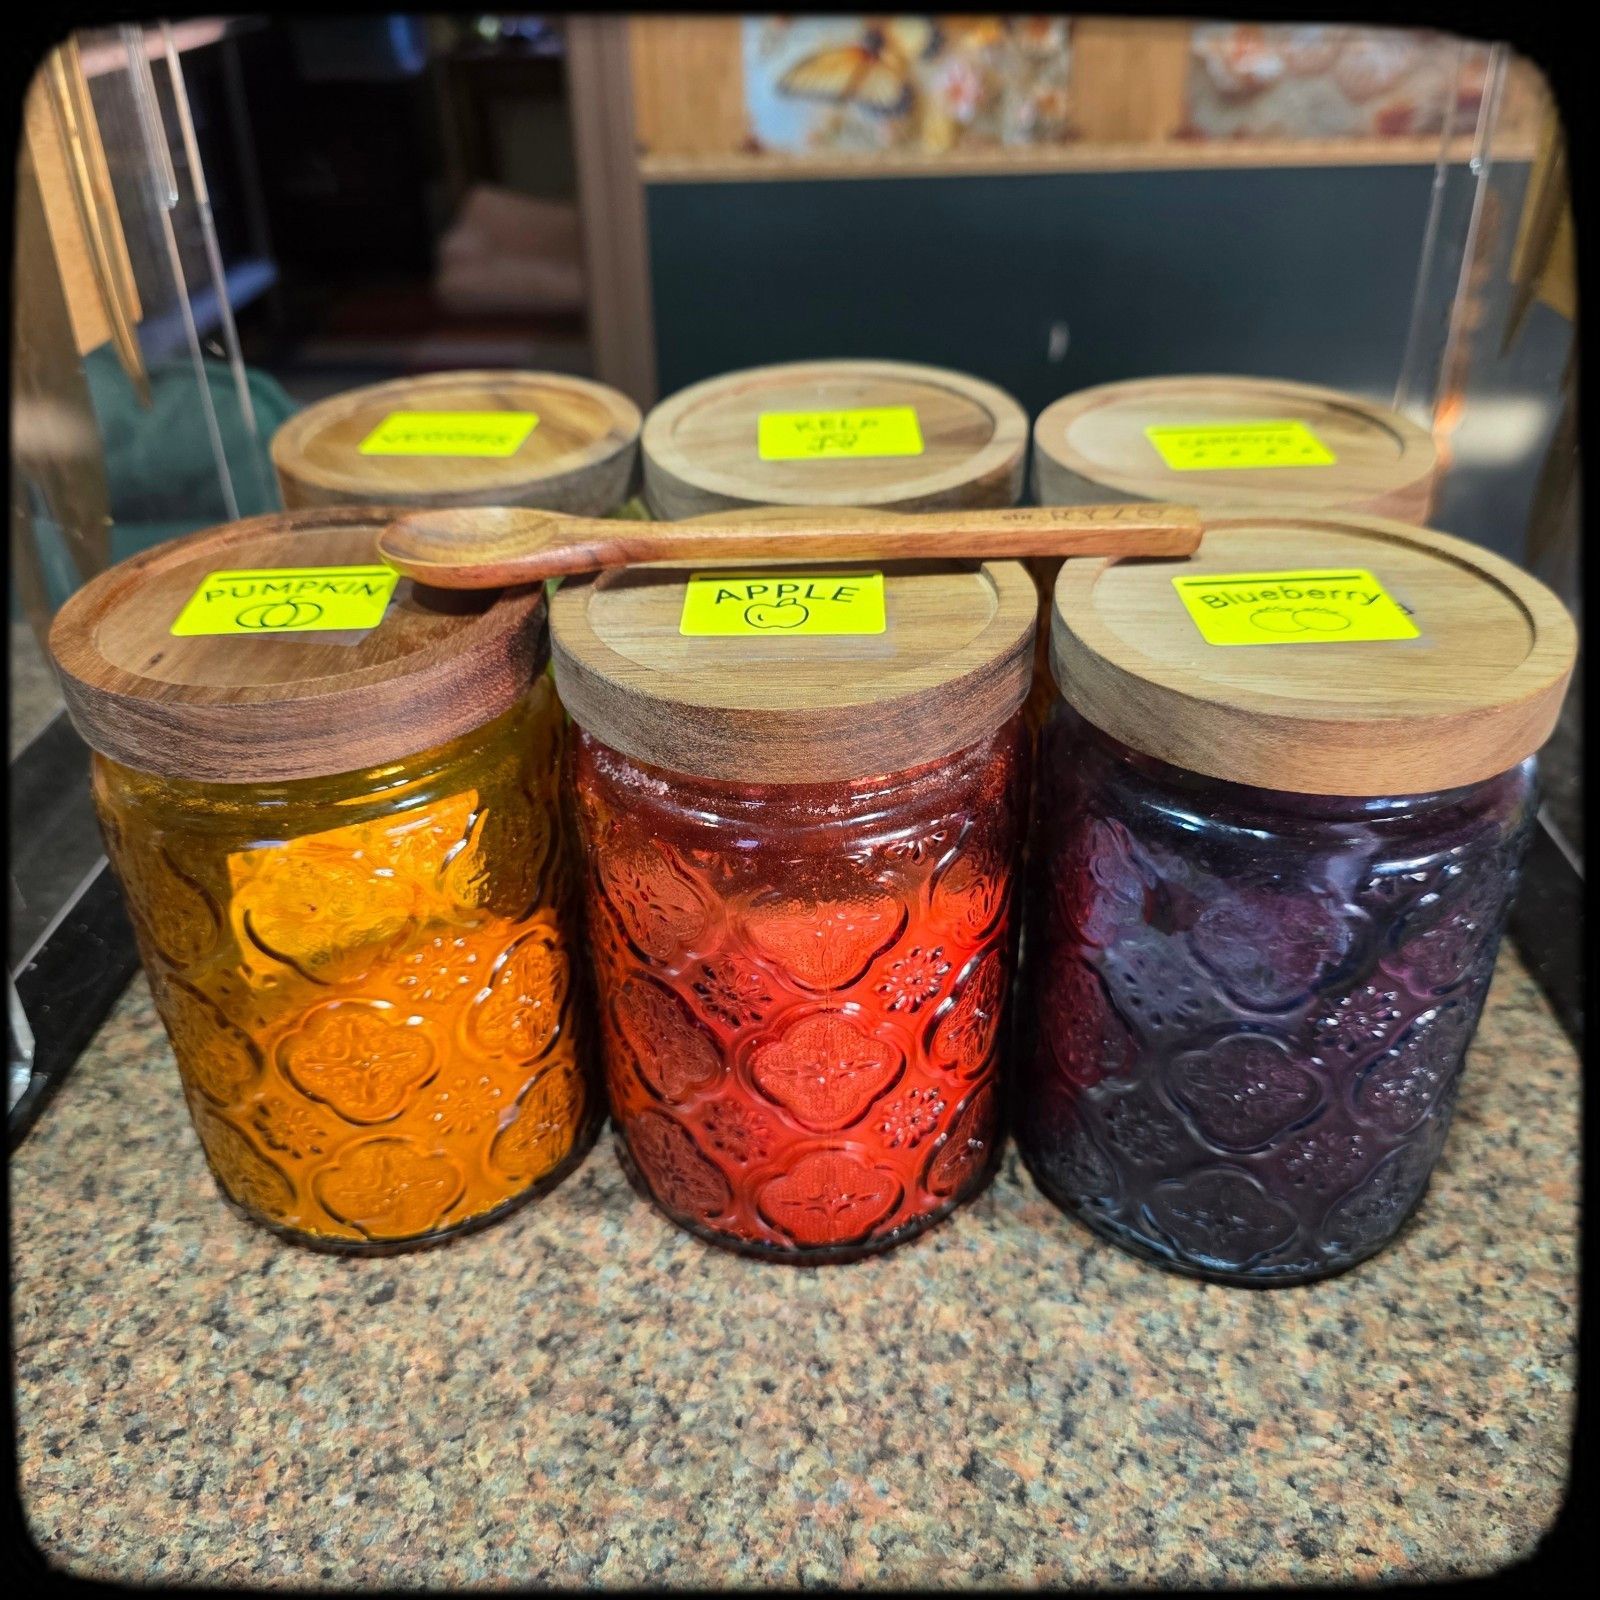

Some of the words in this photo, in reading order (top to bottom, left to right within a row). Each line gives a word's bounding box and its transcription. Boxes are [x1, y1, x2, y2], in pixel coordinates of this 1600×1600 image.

[205, 580, 386, 602] PUMPKIN
[714, 583, 860, 605] APPLE
[1199, 585, 1381, 609] Blueberry
